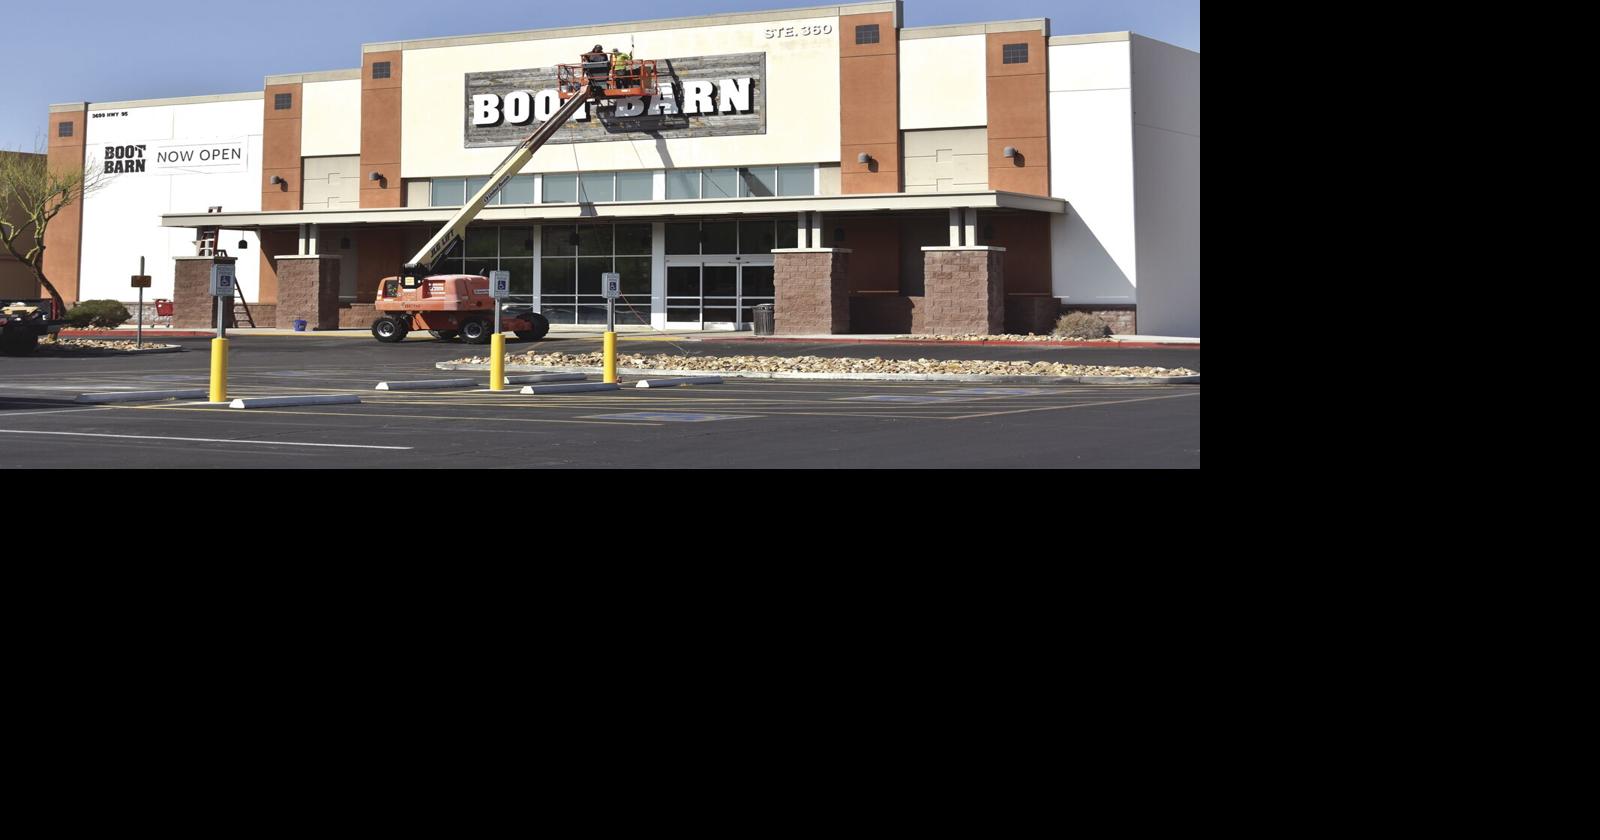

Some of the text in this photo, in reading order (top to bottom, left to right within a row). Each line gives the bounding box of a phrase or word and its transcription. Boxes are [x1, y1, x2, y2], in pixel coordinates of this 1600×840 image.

[765, 24, 833, 39] STE. 360
[614, 77, 756, 118] BARN
[104, 145, 147, 160] BOOT
[157, 148, 241, 163] NOW OPEN
[104, 159, 146, 174] BARN
